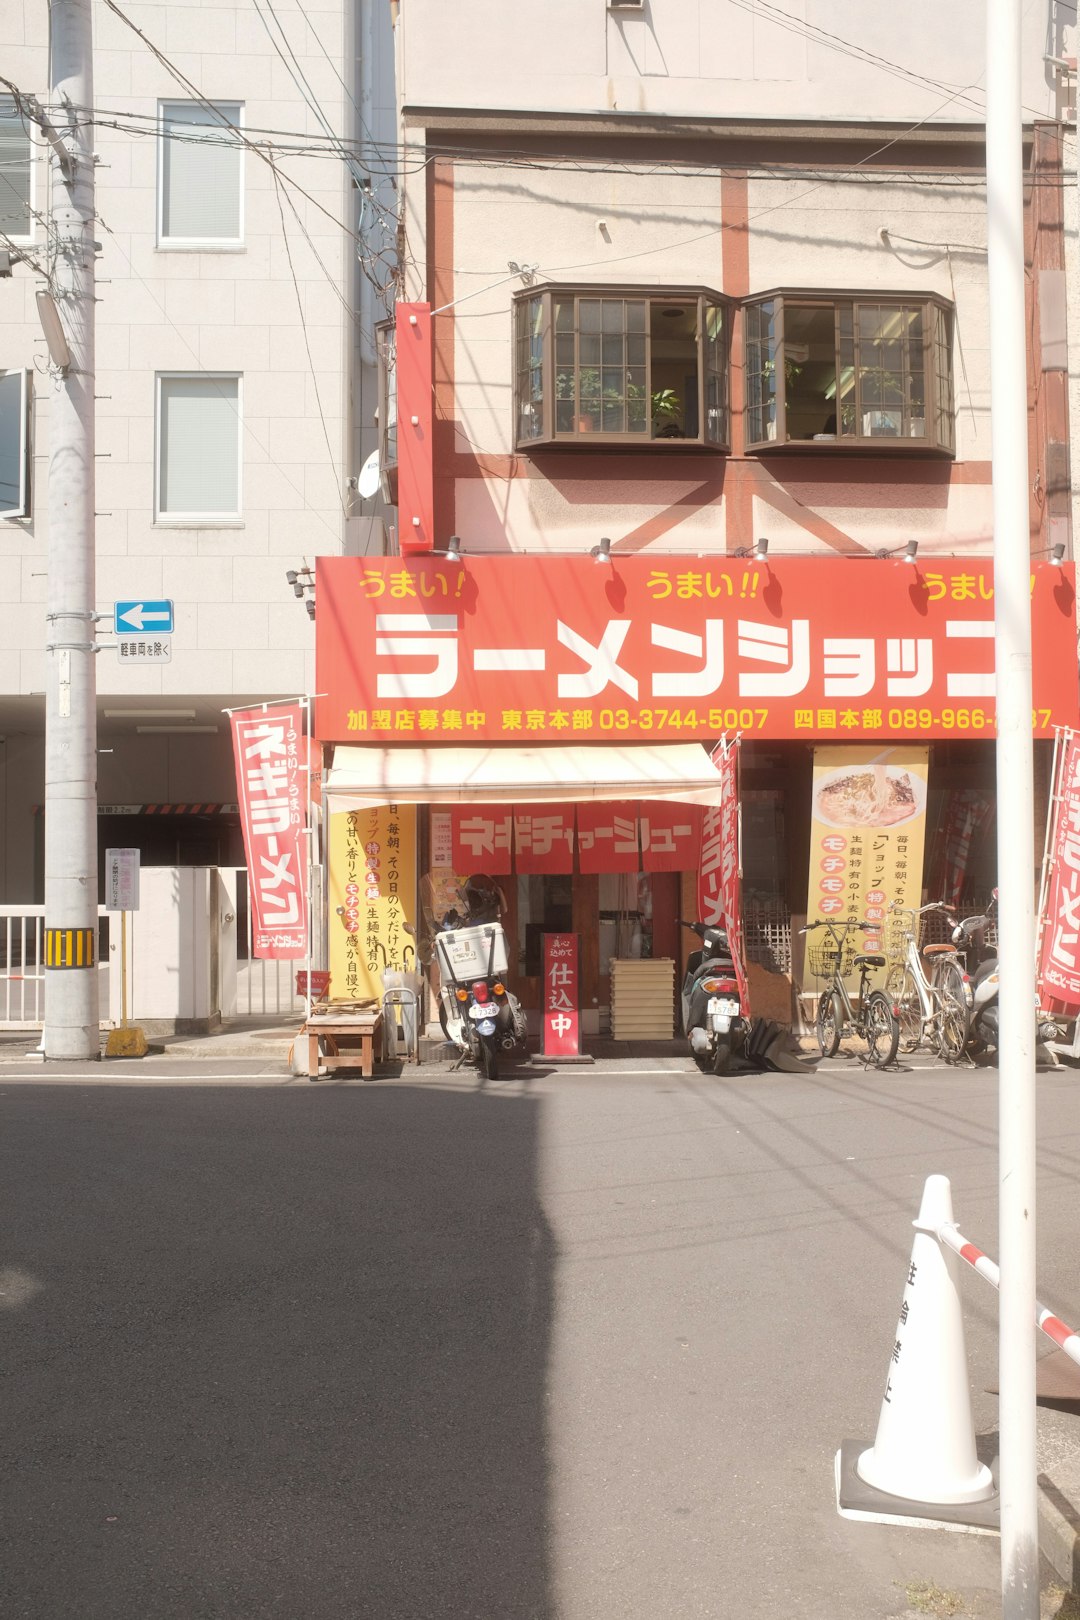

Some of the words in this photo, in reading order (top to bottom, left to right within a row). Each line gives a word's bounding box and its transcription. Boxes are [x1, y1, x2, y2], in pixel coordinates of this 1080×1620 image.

[646, 571, 760, 599] うまい!!
[121, 641, 169, 657] 軽車両を除く
[347, 708, 487, 731] 加盟店募集中
[501, 708, 593, 731] 東京本部
[599, 708, 769, 730] 03-3744-5007
[794, 708, 883, 730] 四国本部
[243, 724, 299, 925] ネギラーメン
[459, 815, 692, 856] ネギチャーシュー
[548, 962, 576, 1038] 仕込中
